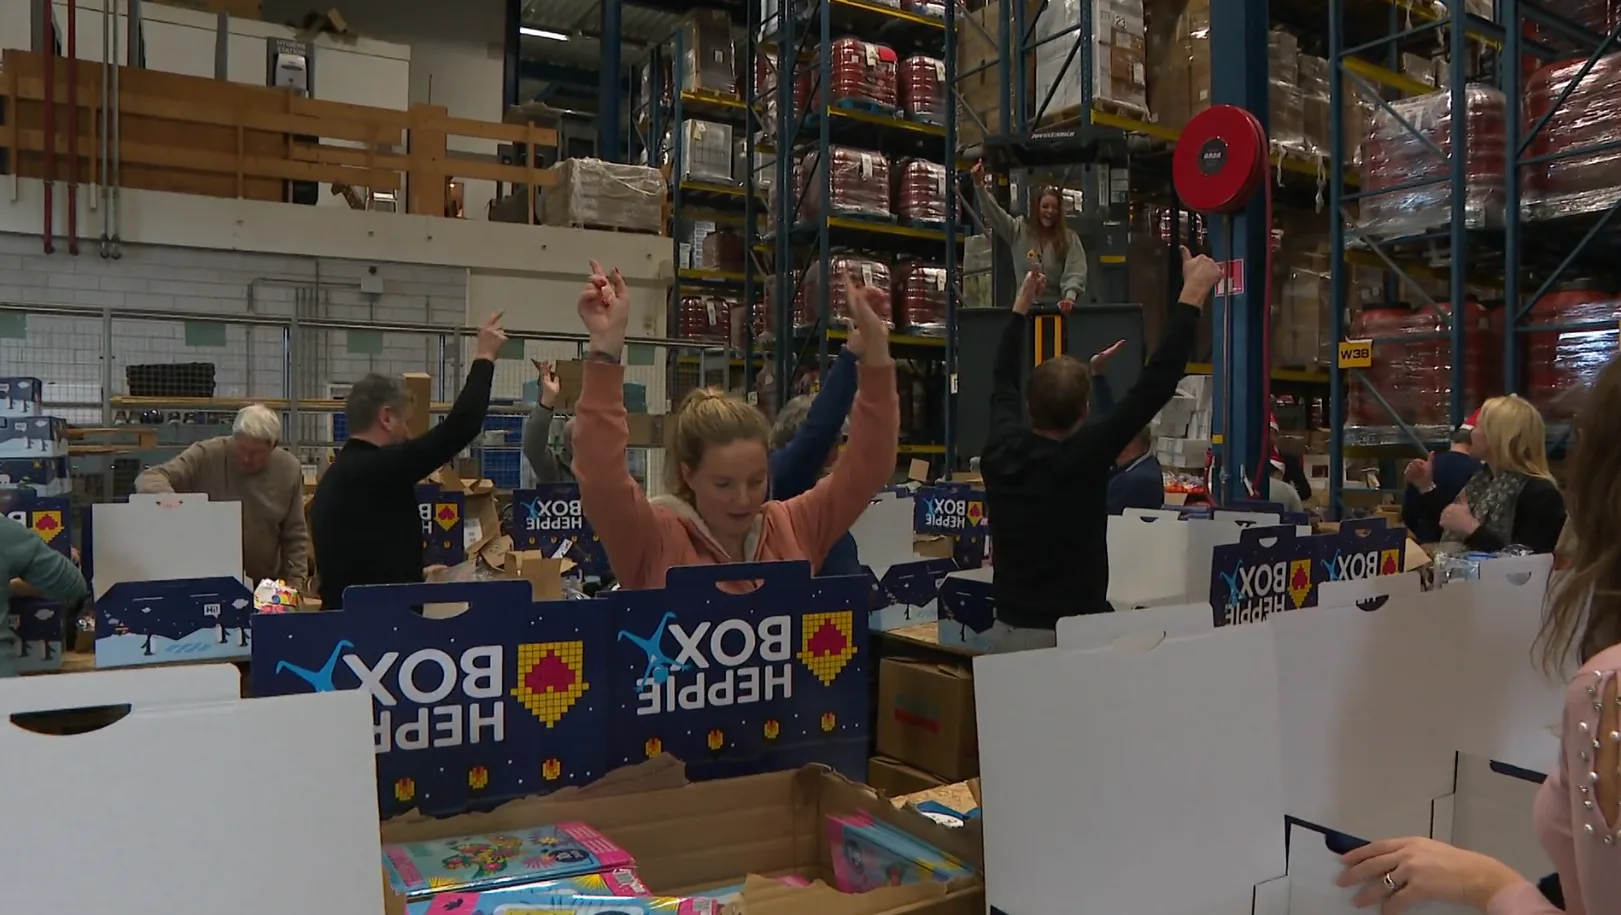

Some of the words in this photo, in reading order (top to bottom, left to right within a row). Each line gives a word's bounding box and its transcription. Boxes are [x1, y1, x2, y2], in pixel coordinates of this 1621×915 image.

[1115, 15, 1126, 29] 23
[1340, 348, 1369, 360] W38
[537, 500, 582, 517] BOX
[934, 498, 966, 516] BOX
[525, 516, 582, 530] HEPPIE
[925, 513, 965, 529] HEPPIE
[1337, 551, 1378, 581] BOX
[1239, 561, 1287, 597] BOX
[206, 605, 219, 614] Hi!
[668, 615, 791, 671] BOX
[342, 645, 503, 706] BOX
[636, 663, 792, 715] HEPPIE
